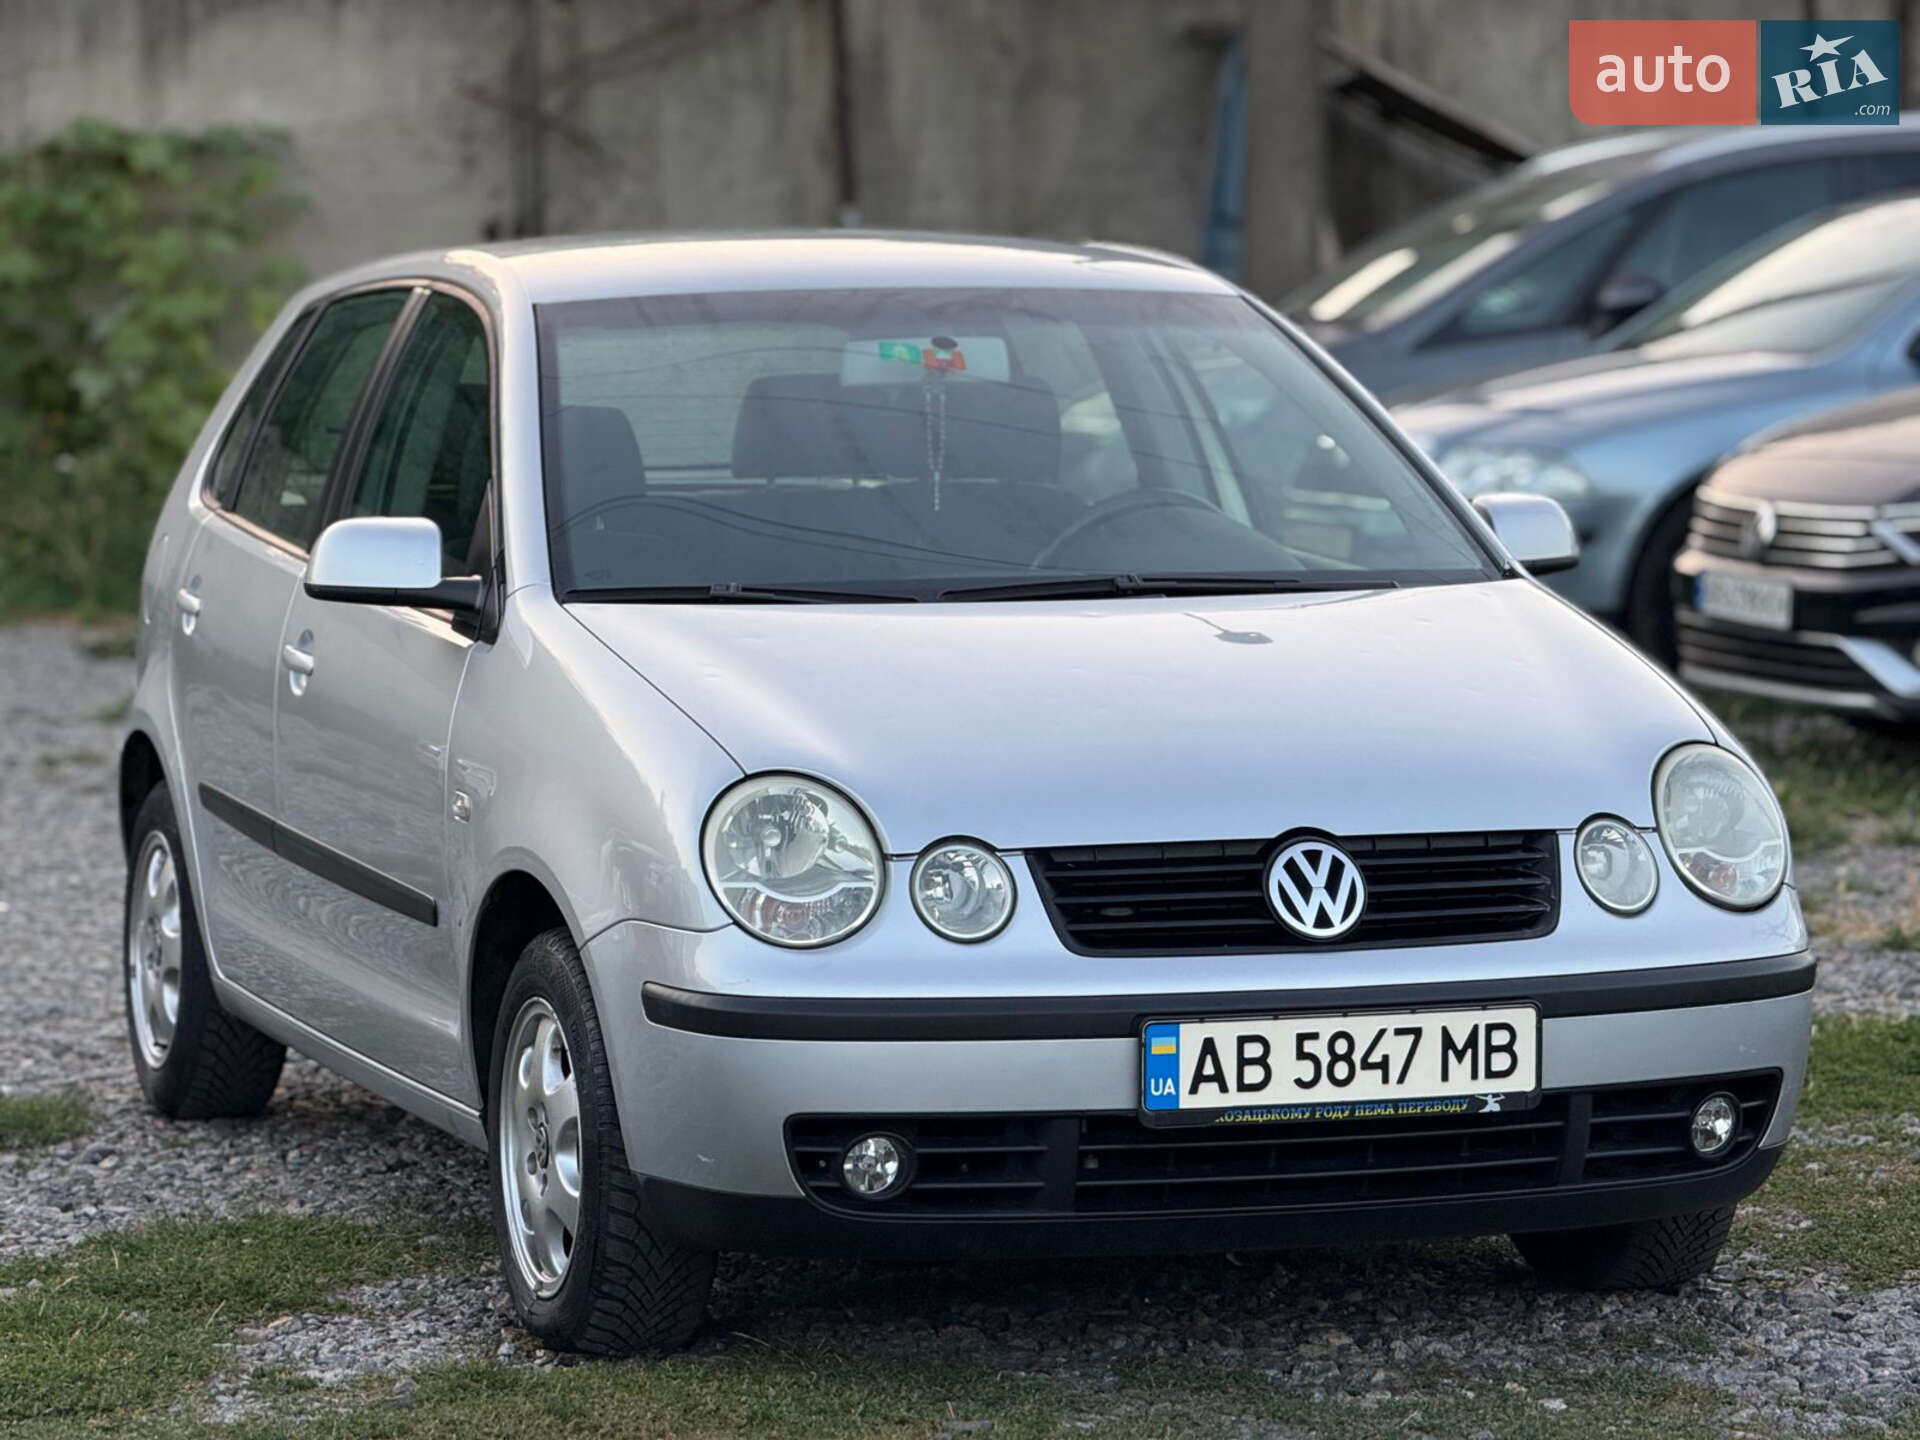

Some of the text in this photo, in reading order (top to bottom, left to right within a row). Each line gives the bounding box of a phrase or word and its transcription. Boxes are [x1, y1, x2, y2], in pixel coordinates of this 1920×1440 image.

[1269, 842, 1364, 937] VW
[1188, 1022, 1519, 1095] AB 5847 MB
[1151, 1078, 1176, 1096] UA
[1315, 1104, 1352, 1120] РОДУ
[1398, 1098, 1469, 1113] ПЕРЕВОДУ
